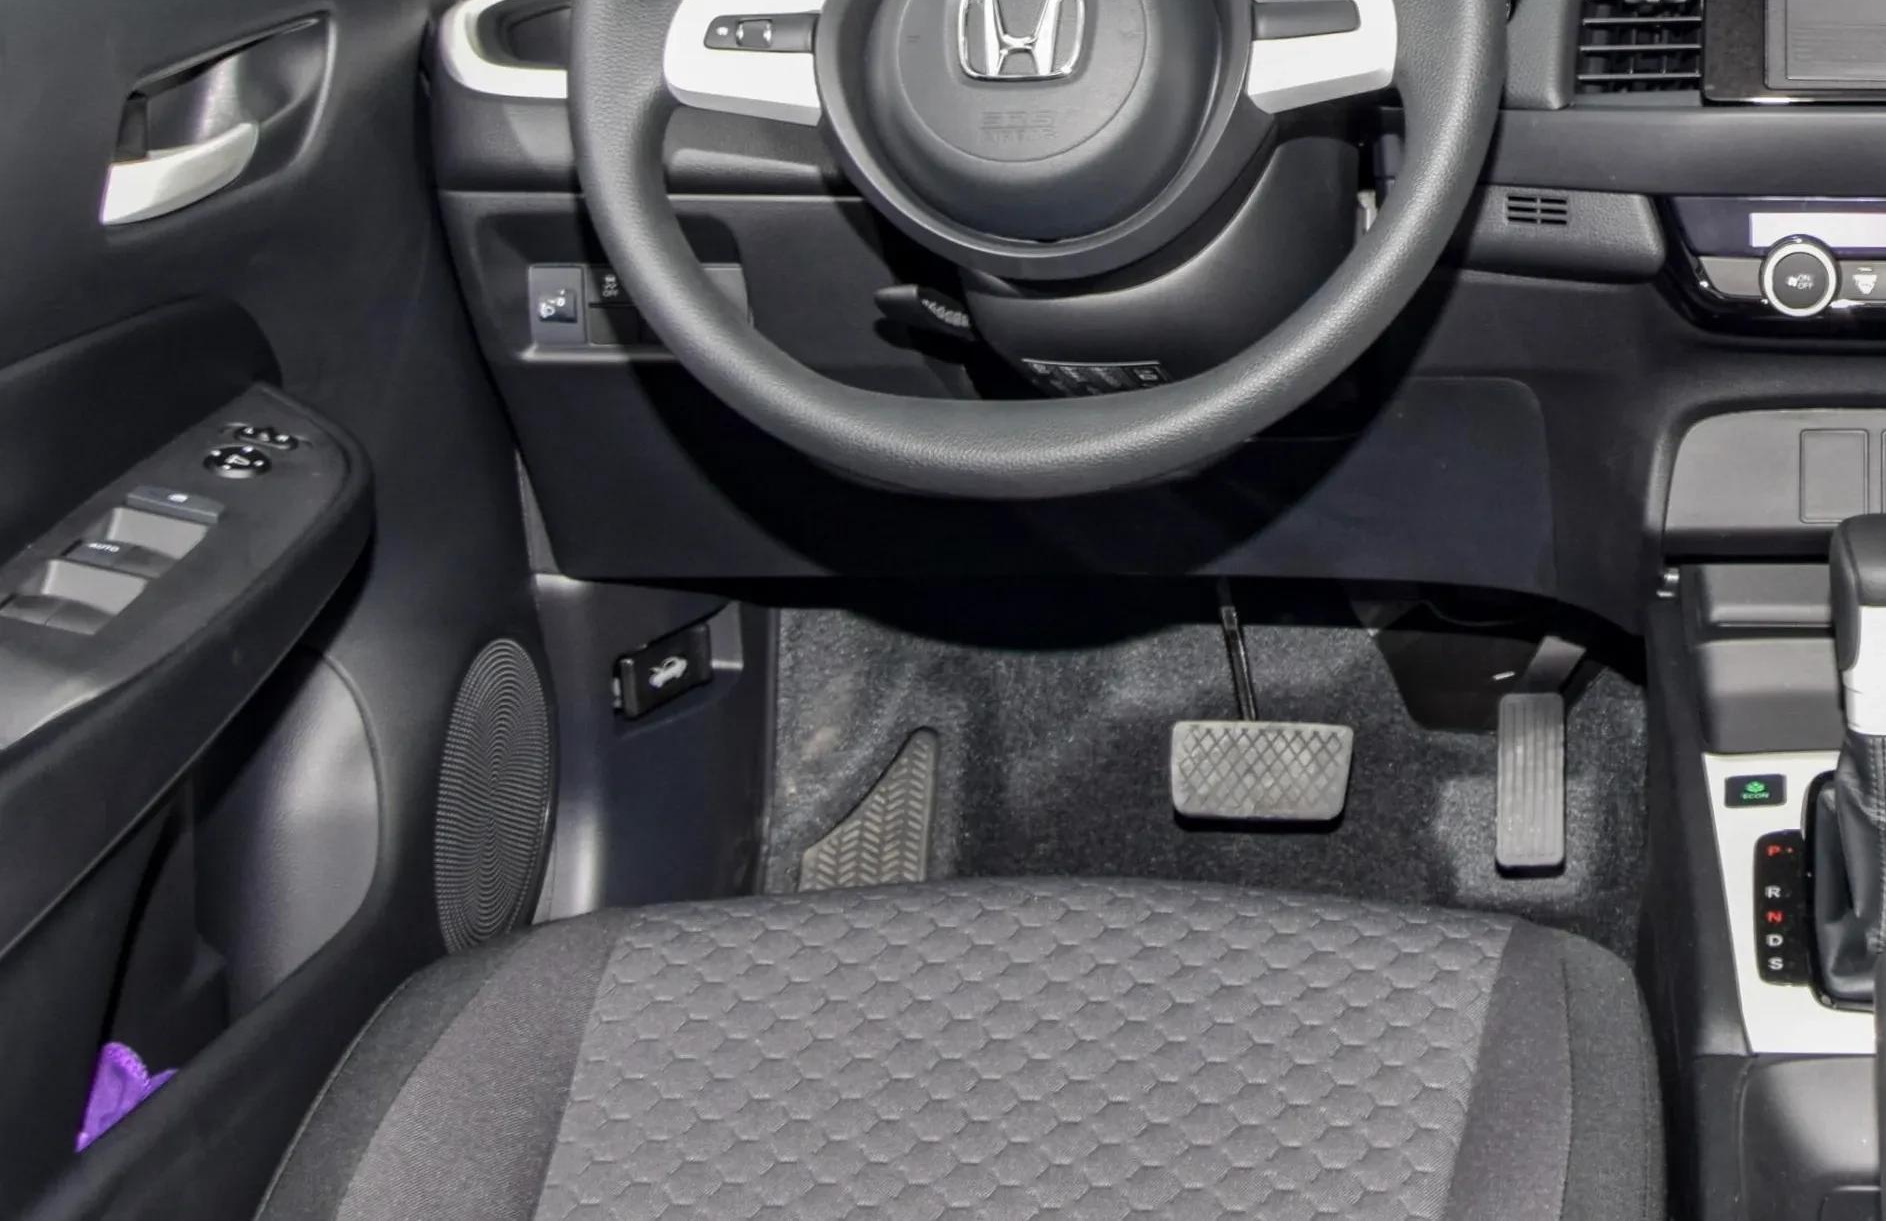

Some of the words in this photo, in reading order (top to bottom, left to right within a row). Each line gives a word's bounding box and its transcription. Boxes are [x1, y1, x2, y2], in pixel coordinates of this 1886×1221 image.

[1797, 282, 1814, 290] OFF
[88, 543, 120, 553] AUTO
[1740, 792, 1770, 800] ECON
[1766, 844, 1781, 856] P
[1766, 885, 1782, 899] R
[1766, 911, 1783, 923] N
[1766, 934, 1783, 947] D
[1768, 957, 1784, 970] S
